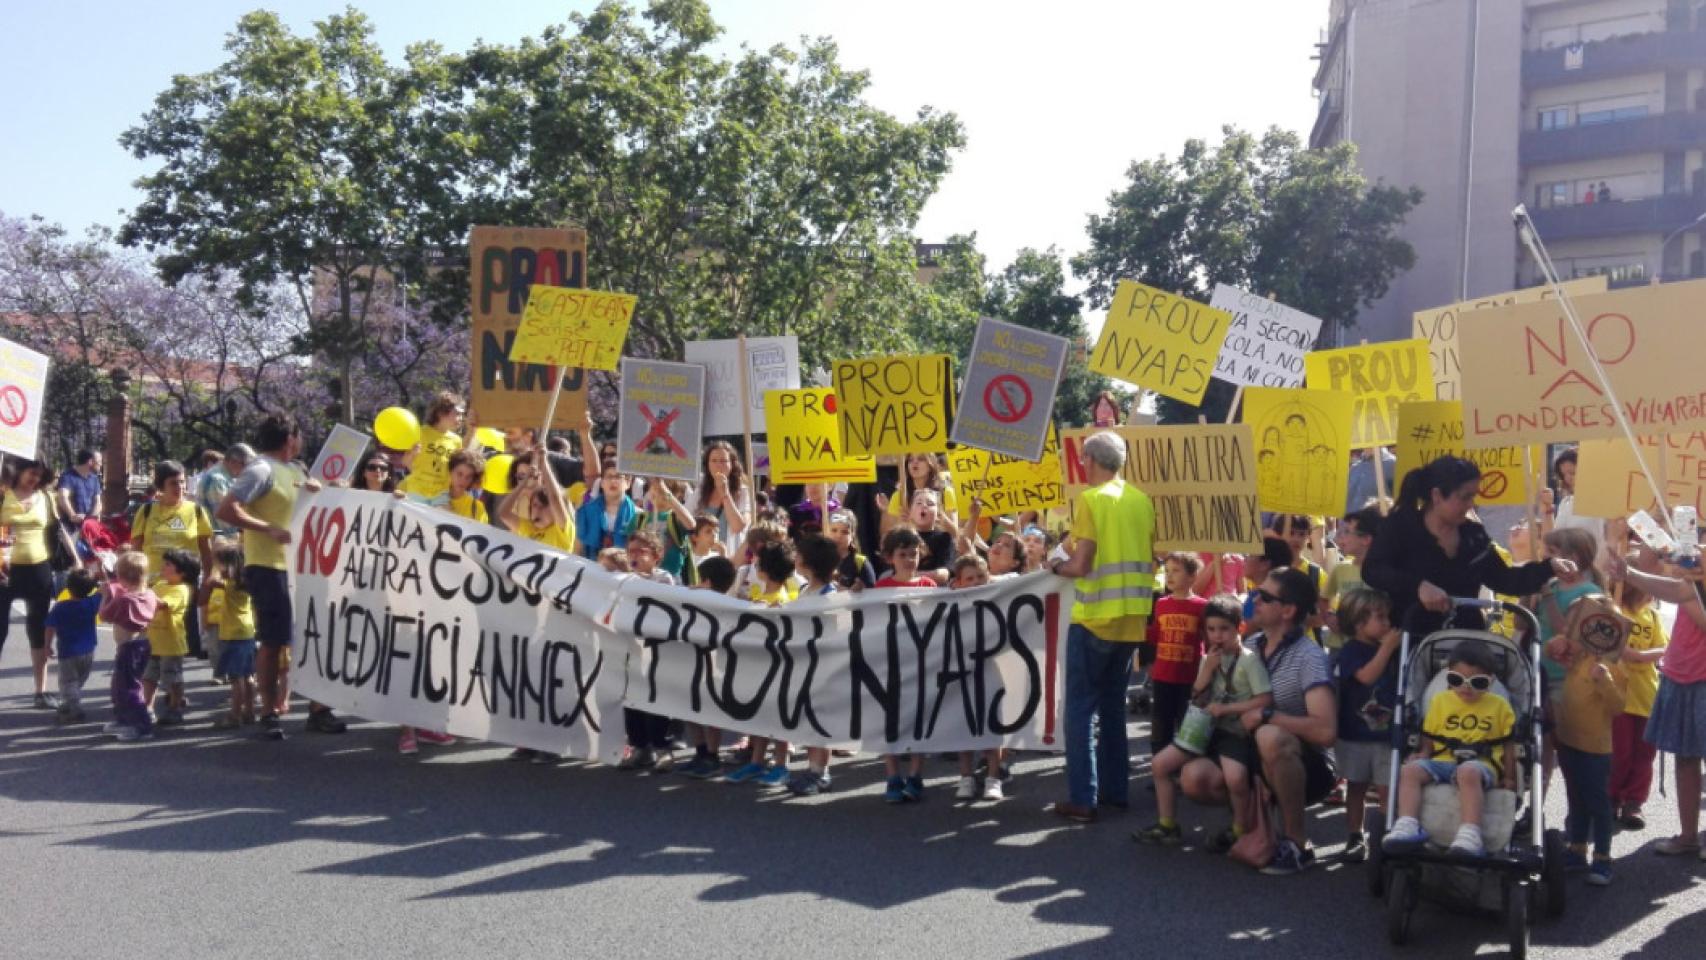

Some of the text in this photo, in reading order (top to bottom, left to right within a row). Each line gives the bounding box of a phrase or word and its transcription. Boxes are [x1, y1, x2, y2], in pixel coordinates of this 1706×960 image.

[1127, 287, 1218, 345] PROU
[1099, 331, 1209, 394] NYAPS
[1525, 312, 1635, 375] NO
[837, 359, 944, 401] PROU
[1328, 347, 1417, 395] PROU
[1540, 369, 1603, 399] A
[780, 392, 839, 416] PRO
[1474, 403, 1616, 435] LONDRES
[843, 401, 937, 458] NYAPS
[1063, 436, 1088, 485] N
[1182, 435, 1246, 483] ALTRA
[296, 505, 346, 577] NO
[345, 503, 426, 552] A UNA
[340, 549, 422, 596] ALTRA
[429, 524, 585, 614] ESCOLA
[1630, 623, 1652, 640] OS
[298, 595, 324, 678] A
[461, 629, 602, 733] ANNEX
[633, 592, 1060, 745] PROU NYAPS!
[1446, 714, 1493, 731] SOS
